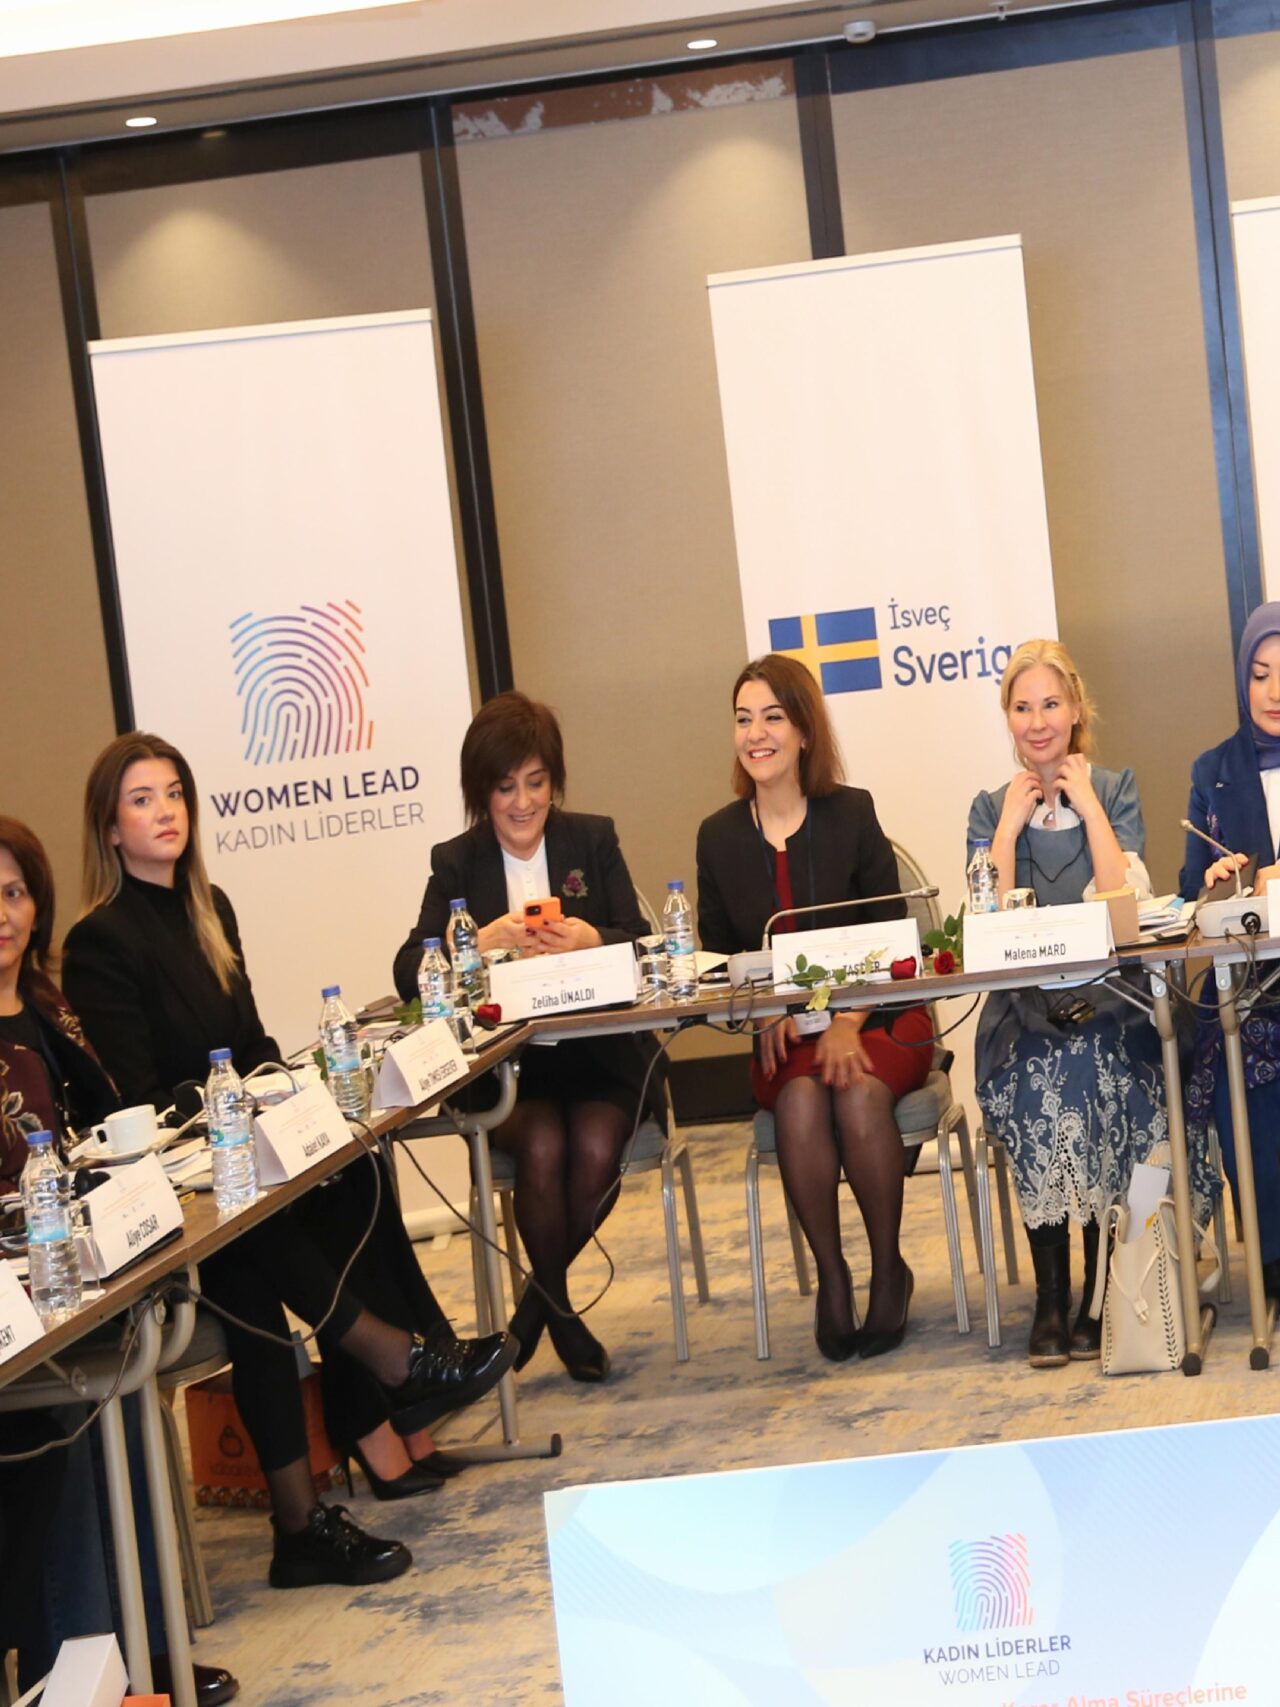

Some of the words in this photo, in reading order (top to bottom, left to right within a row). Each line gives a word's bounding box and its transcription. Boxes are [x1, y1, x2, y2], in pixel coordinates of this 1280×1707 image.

[888, 598, 951, 631] İsveç
[893, 636, 1012, 687] Sverig
[210, 778, 332, 818] WOMEN
[343, 766, 420, 799] LEAD
[216, 821, 295, 854] KADIN
[304, 802, 425, 841] LİDERLER
[1004, 948, 1037, 961] Malena
[1040, 943, 1066, 957] MARD
[532, 995, 559, 1010] Zeliha
[560, 987, 595, 1004] ÜNALDI
[923, 1643, 980, 1664] KADIN
[985, 1635, 1072, 1659] LİDERLER
[939, 1664, 1010, 1686] WOMEN
[1015, 1659, 1061, 1680] LEAD
[1126, 1682, 1248, 1707] Süreçlerine
